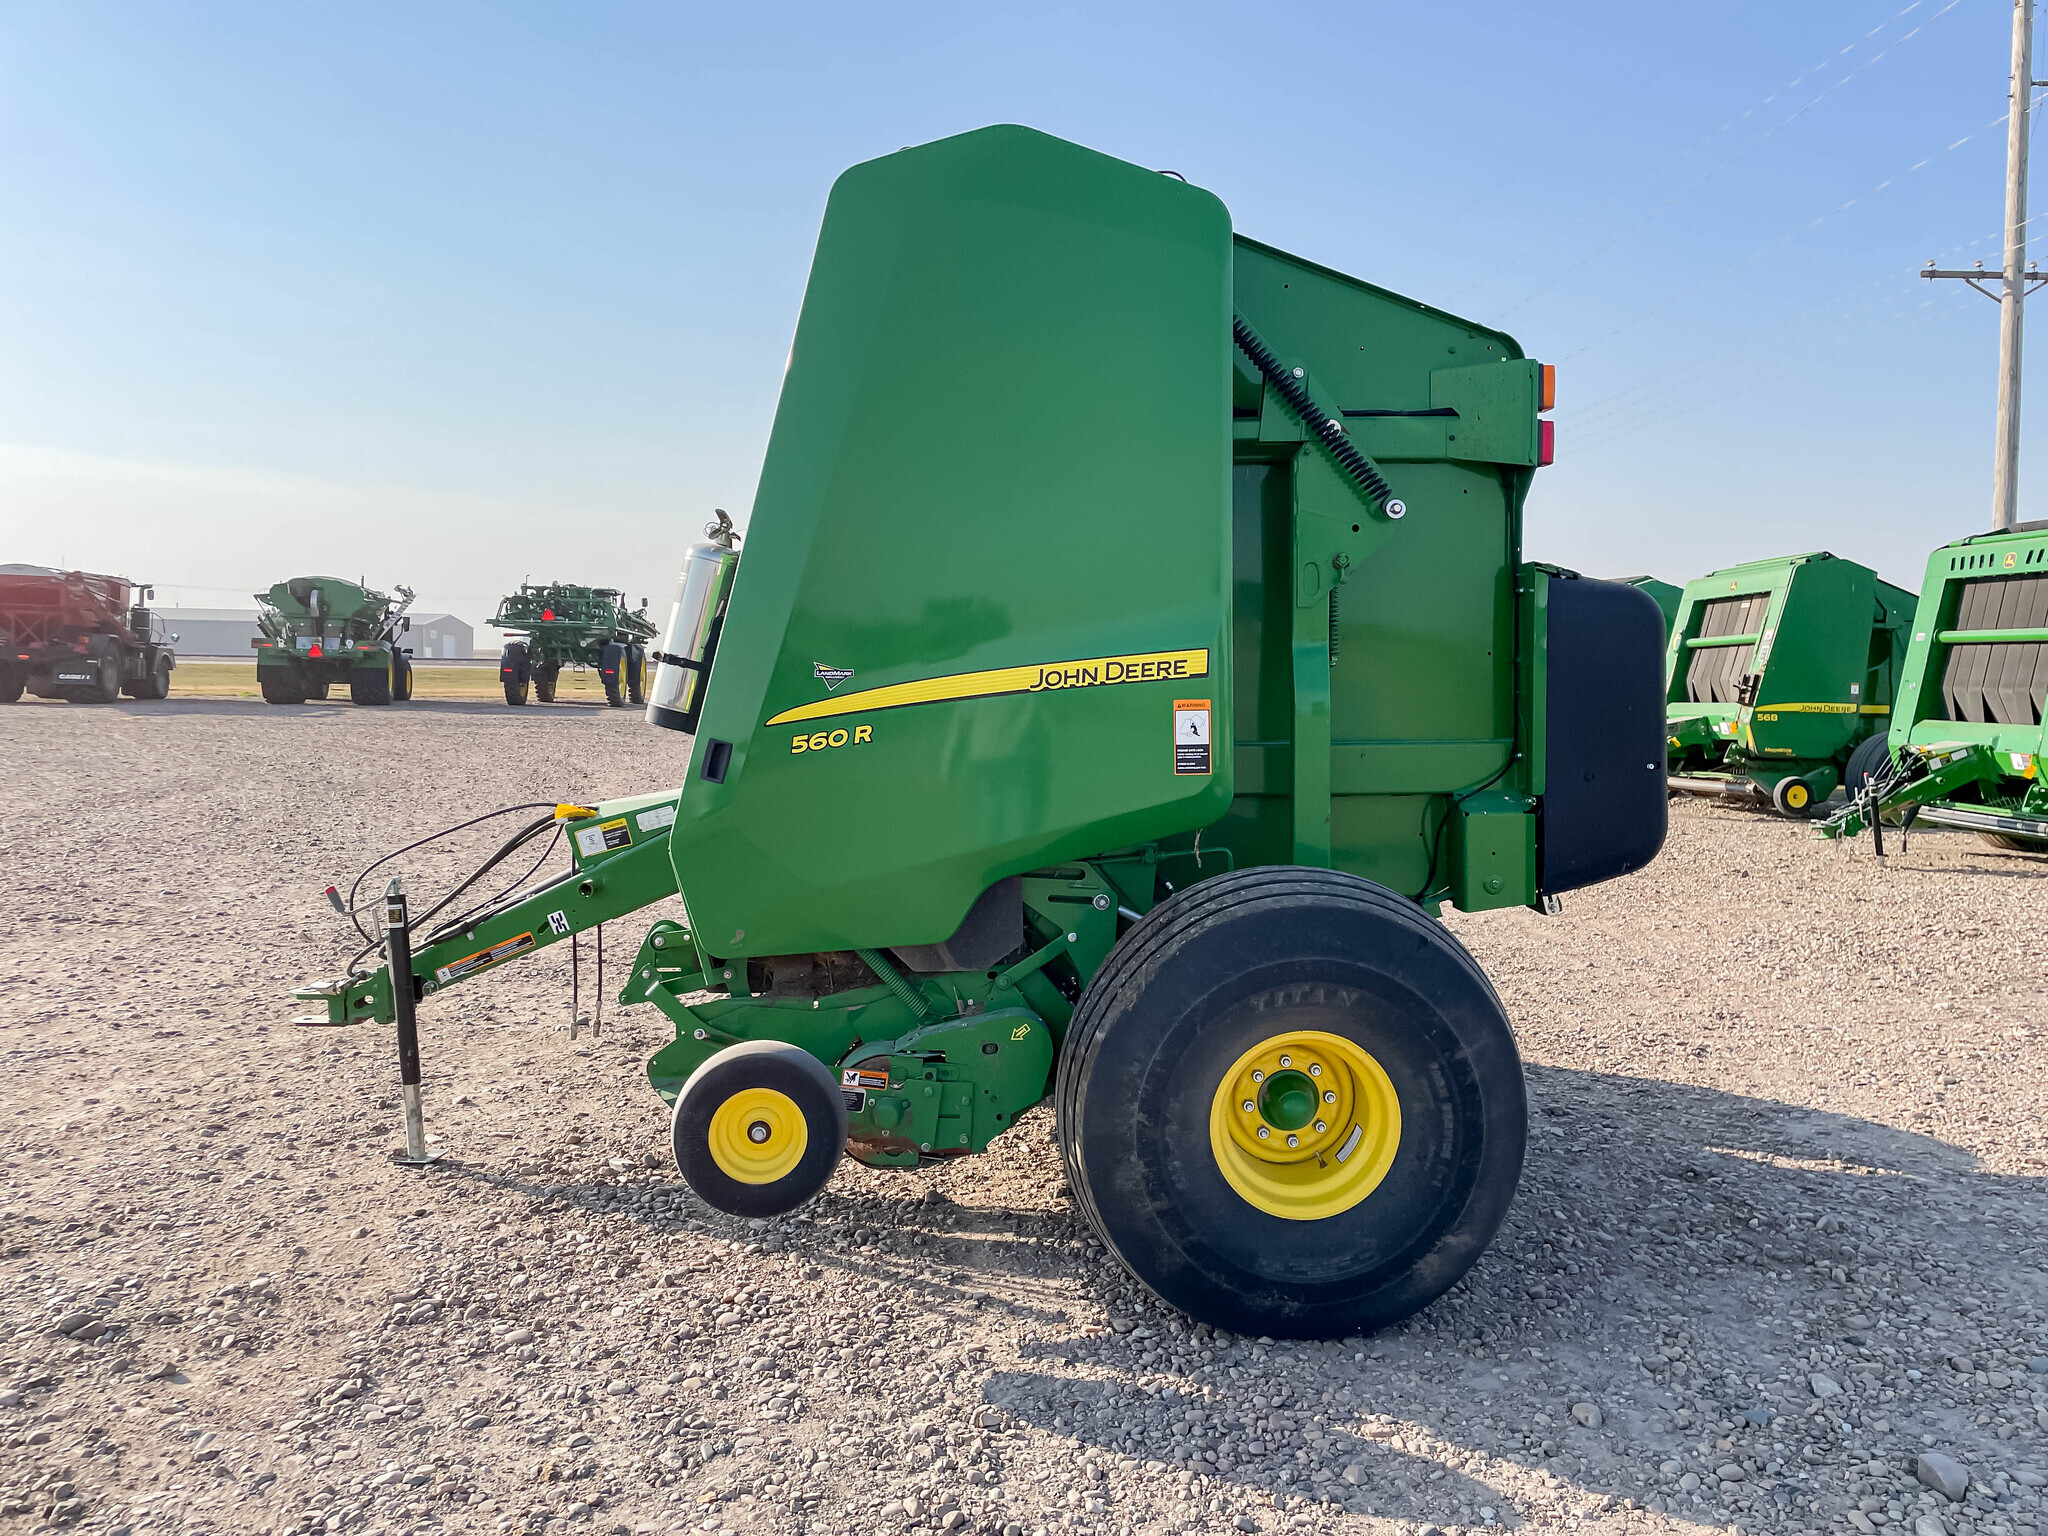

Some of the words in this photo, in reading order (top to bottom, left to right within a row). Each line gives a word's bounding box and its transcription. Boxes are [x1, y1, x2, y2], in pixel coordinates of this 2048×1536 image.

[1029, 666, 1099, 689] JOHN
[1105, 659, 1188, 681] DEERE
[1800, 704, 1823, 713] JOHN
[1823, 704, 1852, 713] DEERE
[791, 728, 849, 754] 560
[853, 724, 873, 744] R
[1249, 985, 1358, 1015] TITAN
